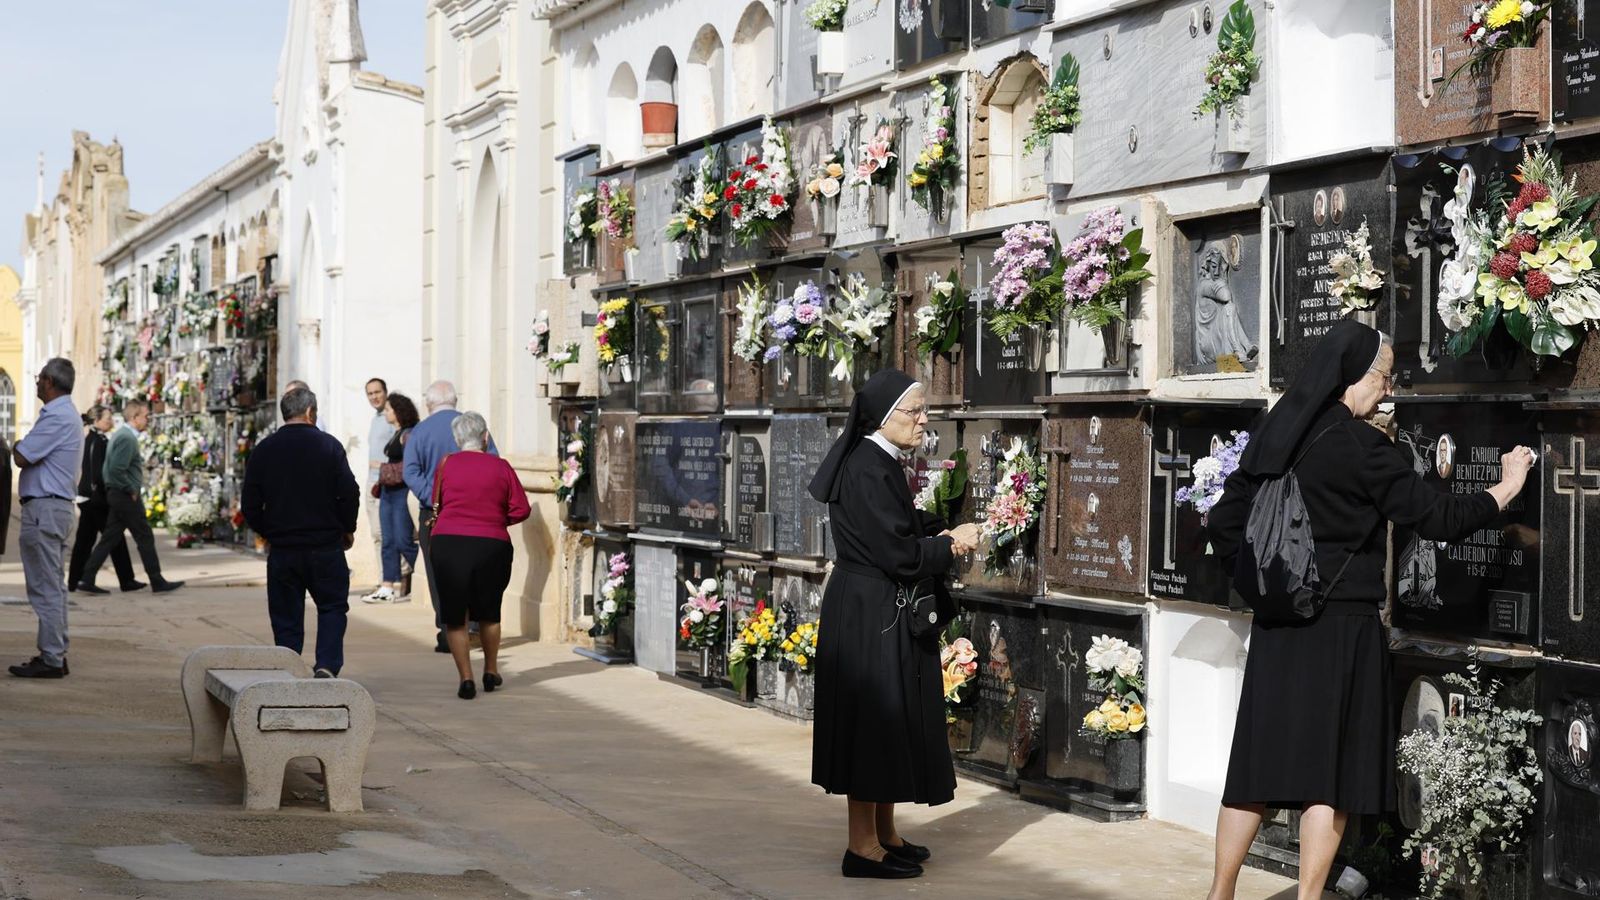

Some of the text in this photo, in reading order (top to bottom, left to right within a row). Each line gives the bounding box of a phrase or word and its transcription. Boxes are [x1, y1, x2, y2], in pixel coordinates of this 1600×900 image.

[1471, 446, 1500, 464] ENRIQUE
[1456, 464, 1503, 481] BENITEZ PINT
[1448, 544, 1486, 563] CALDERON
